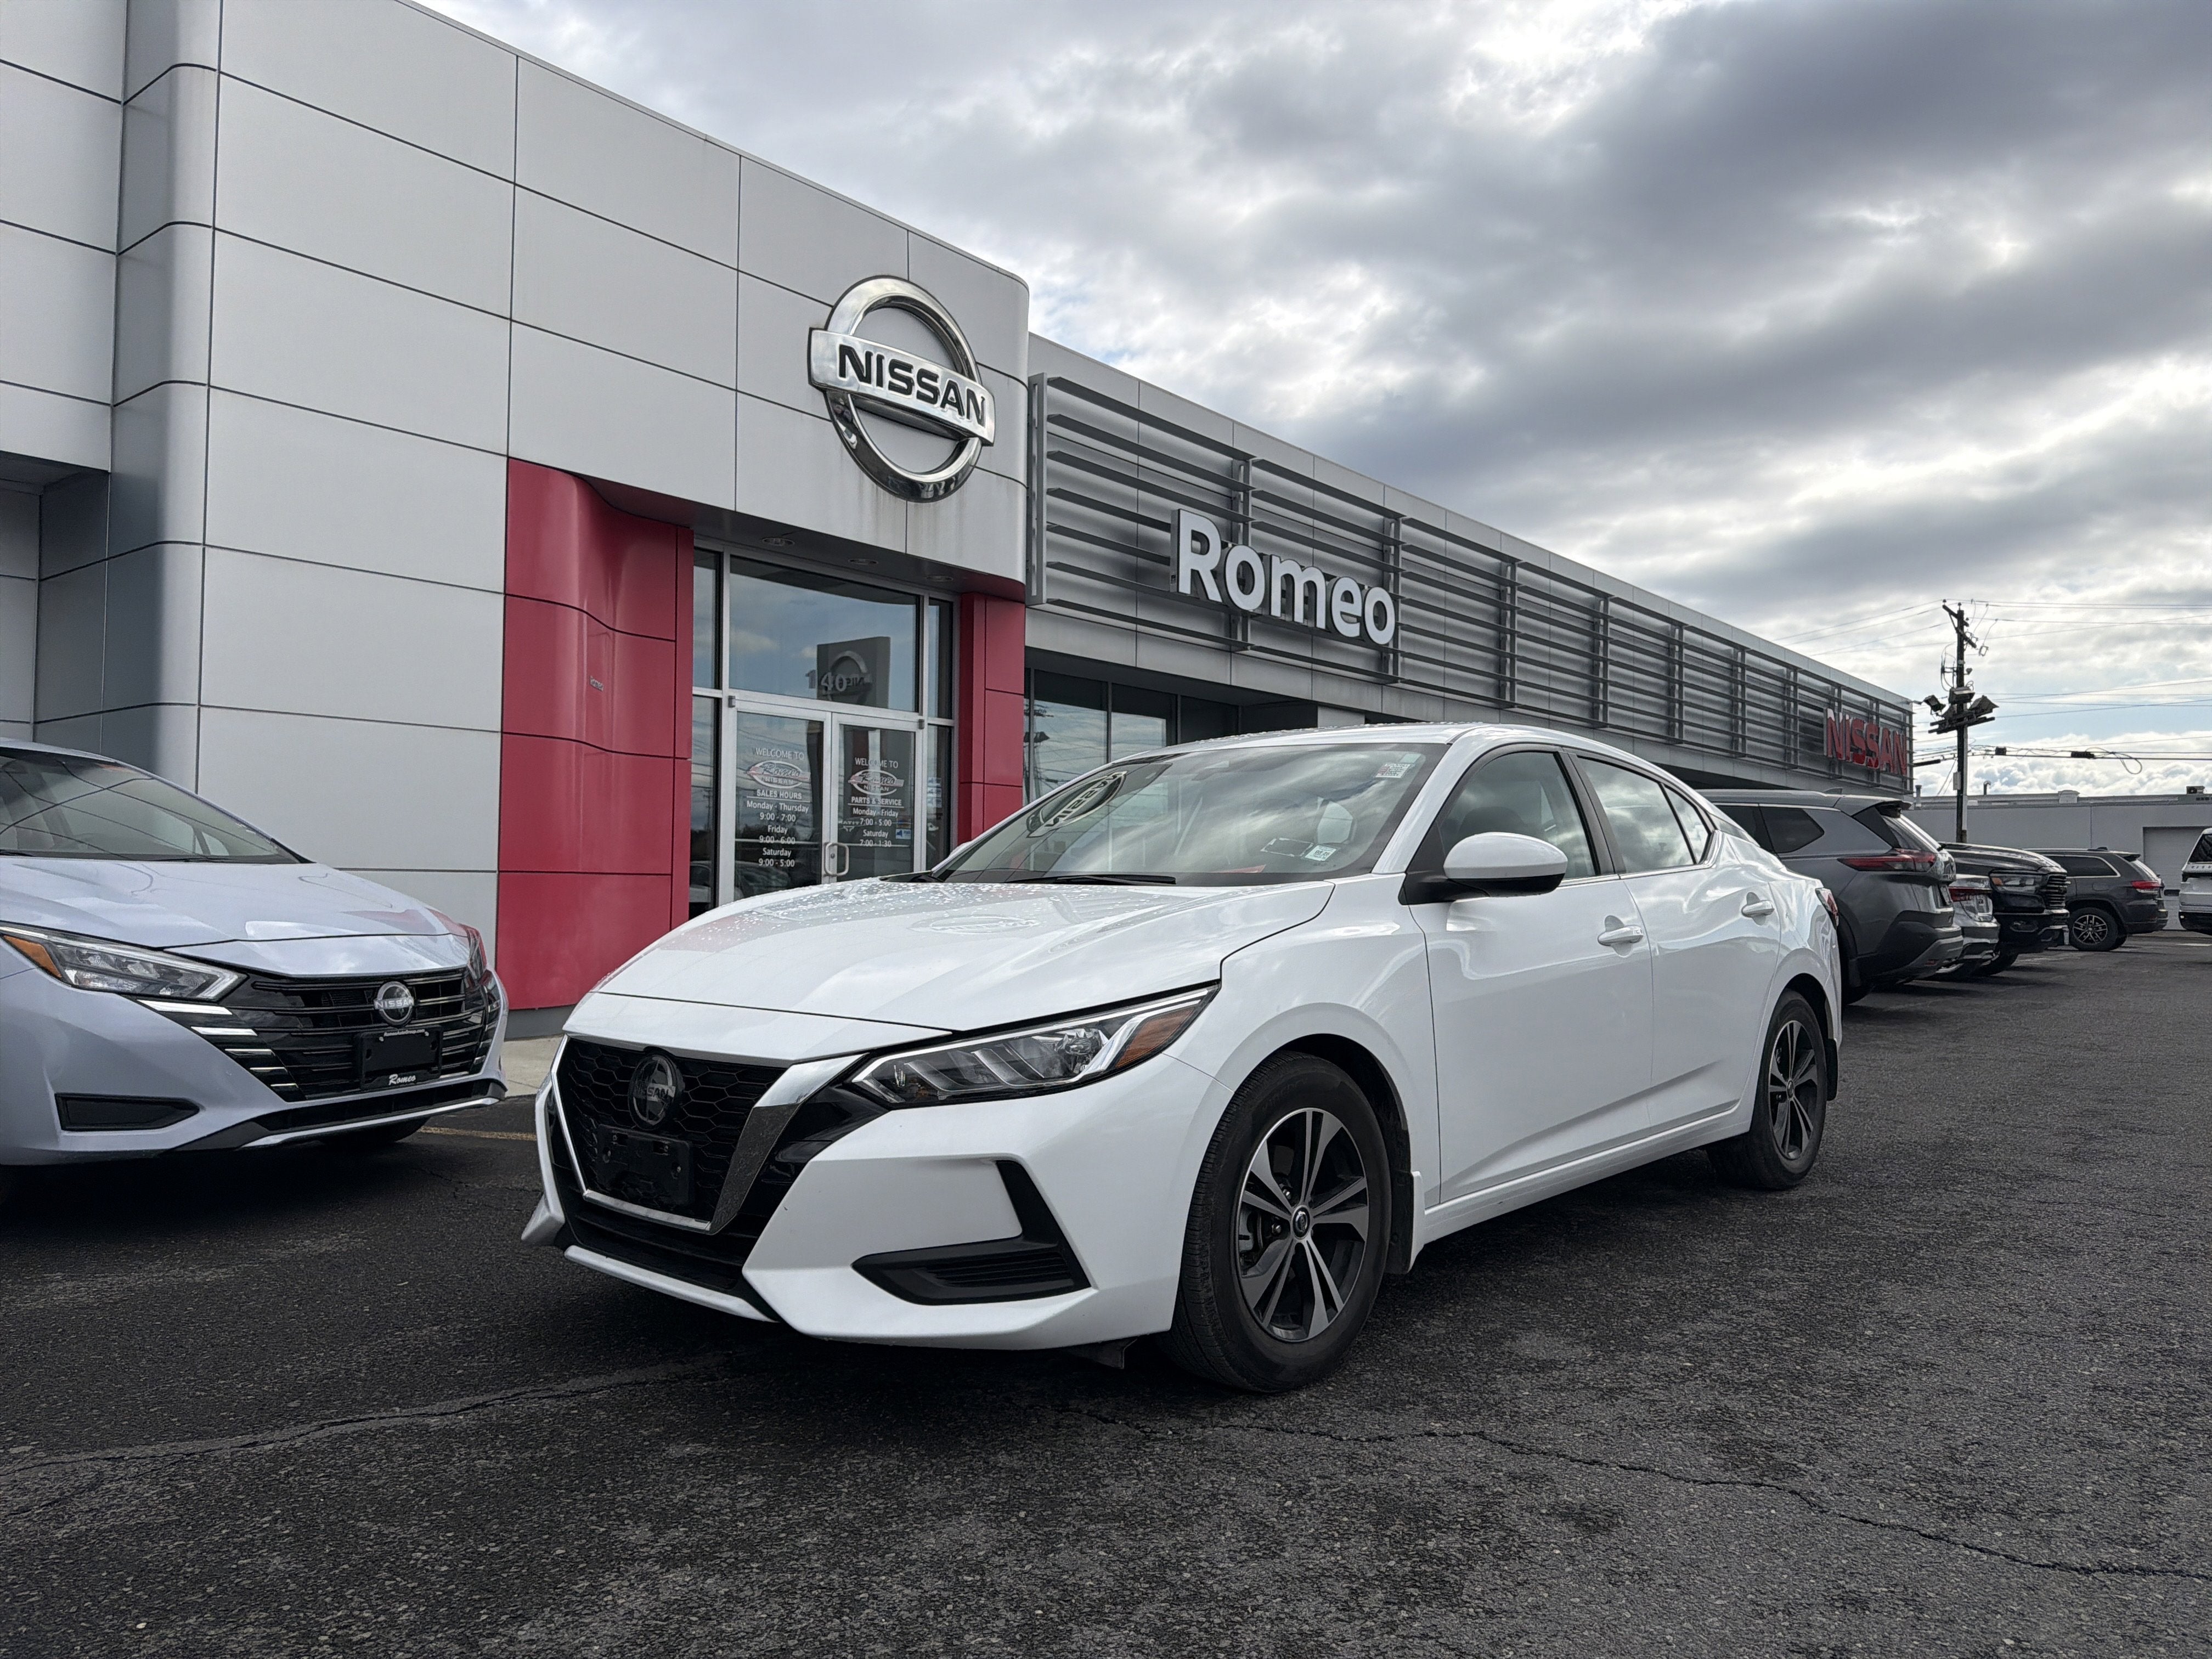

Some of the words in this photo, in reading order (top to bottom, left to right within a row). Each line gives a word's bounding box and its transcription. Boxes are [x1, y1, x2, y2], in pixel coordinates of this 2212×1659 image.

[838, 344, 986, 427] NISSAN
[1171, 508, 1396, 645] Romeo
[1824, 708, 1908, 776] NISSAN
[755, 748, 792, 759] WELCOME
[794, 752, 804, 760] TO
[855, 757, 887, 768] WELCOME
[761, 762, 800, 777] Romeo
[851, 796, 870, 804] PARTS
[747, 800, 773, 811] Monday
[779, 803, 809, 814] Thursday
[759, 812, 775, 821] 9:00
[781, 814, 796, 822] 7:00
[853, 808, 876, 817] Monday
[881, 809, 899, 818] Friday
[768, 825, 788, 835] Friday
[863, 830, 889, 839] Saturday
[759, 835, 775, 843] 9:00
[763, 848, 792, 857] Saturday
[758, 858, 774, 866] 9:00
[375, 999, 414, 1008] NISSAN
[388, 1074, 416, 1086] Romeo
